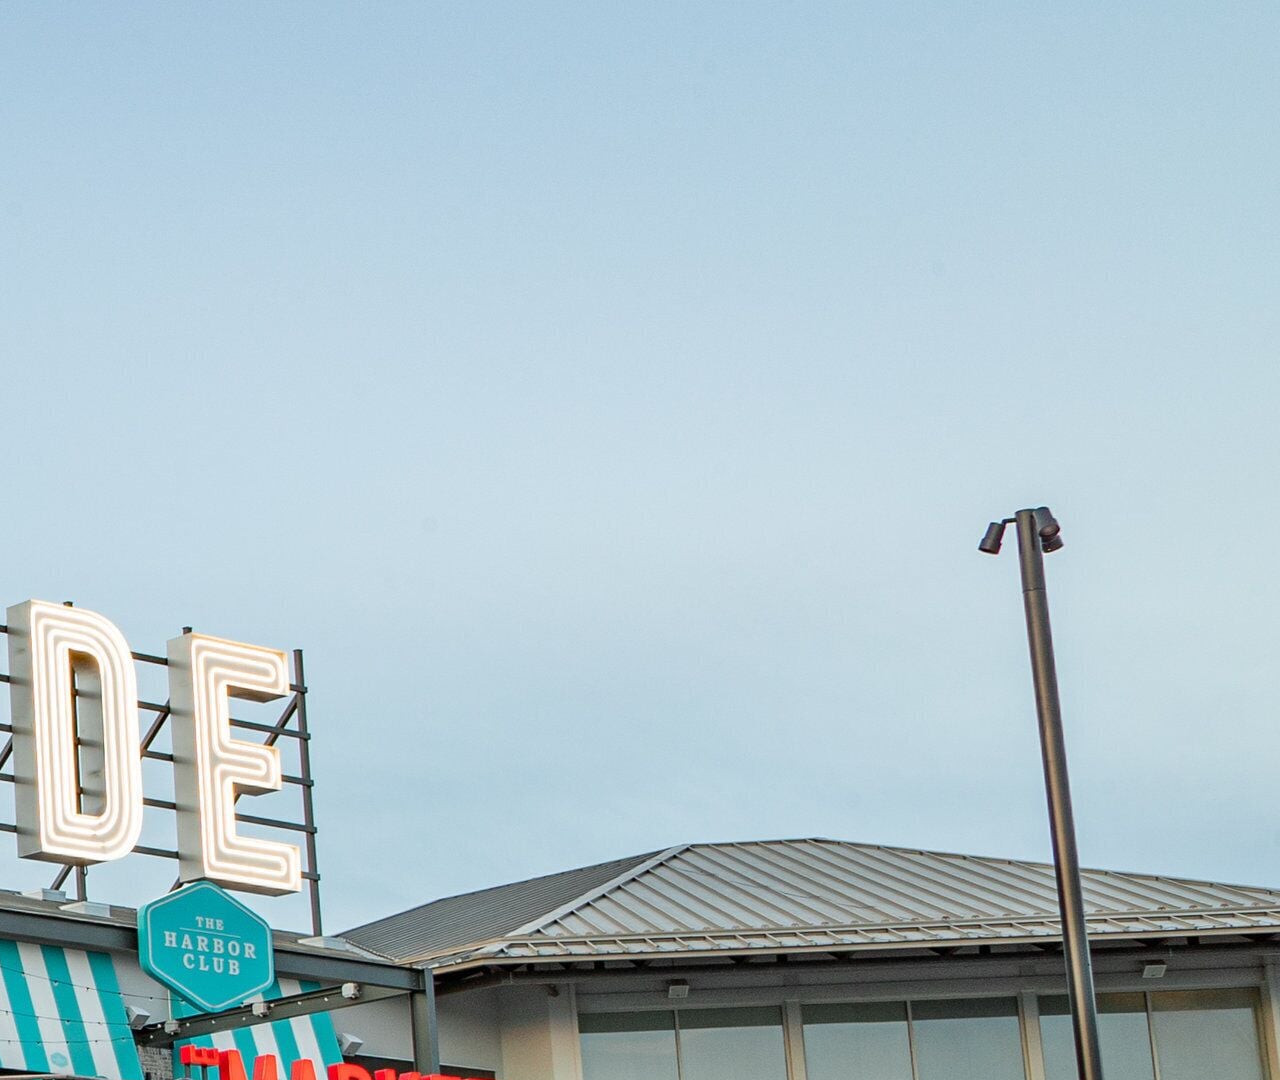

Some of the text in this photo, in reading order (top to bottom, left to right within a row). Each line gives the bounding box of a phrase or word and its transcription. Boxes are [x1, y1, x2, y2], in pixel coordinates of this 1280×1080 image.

[196, 916, 224, 930] THE
[164, 931, 256, 959] HARBOR
[183, 953, 240, 976] CLUB
